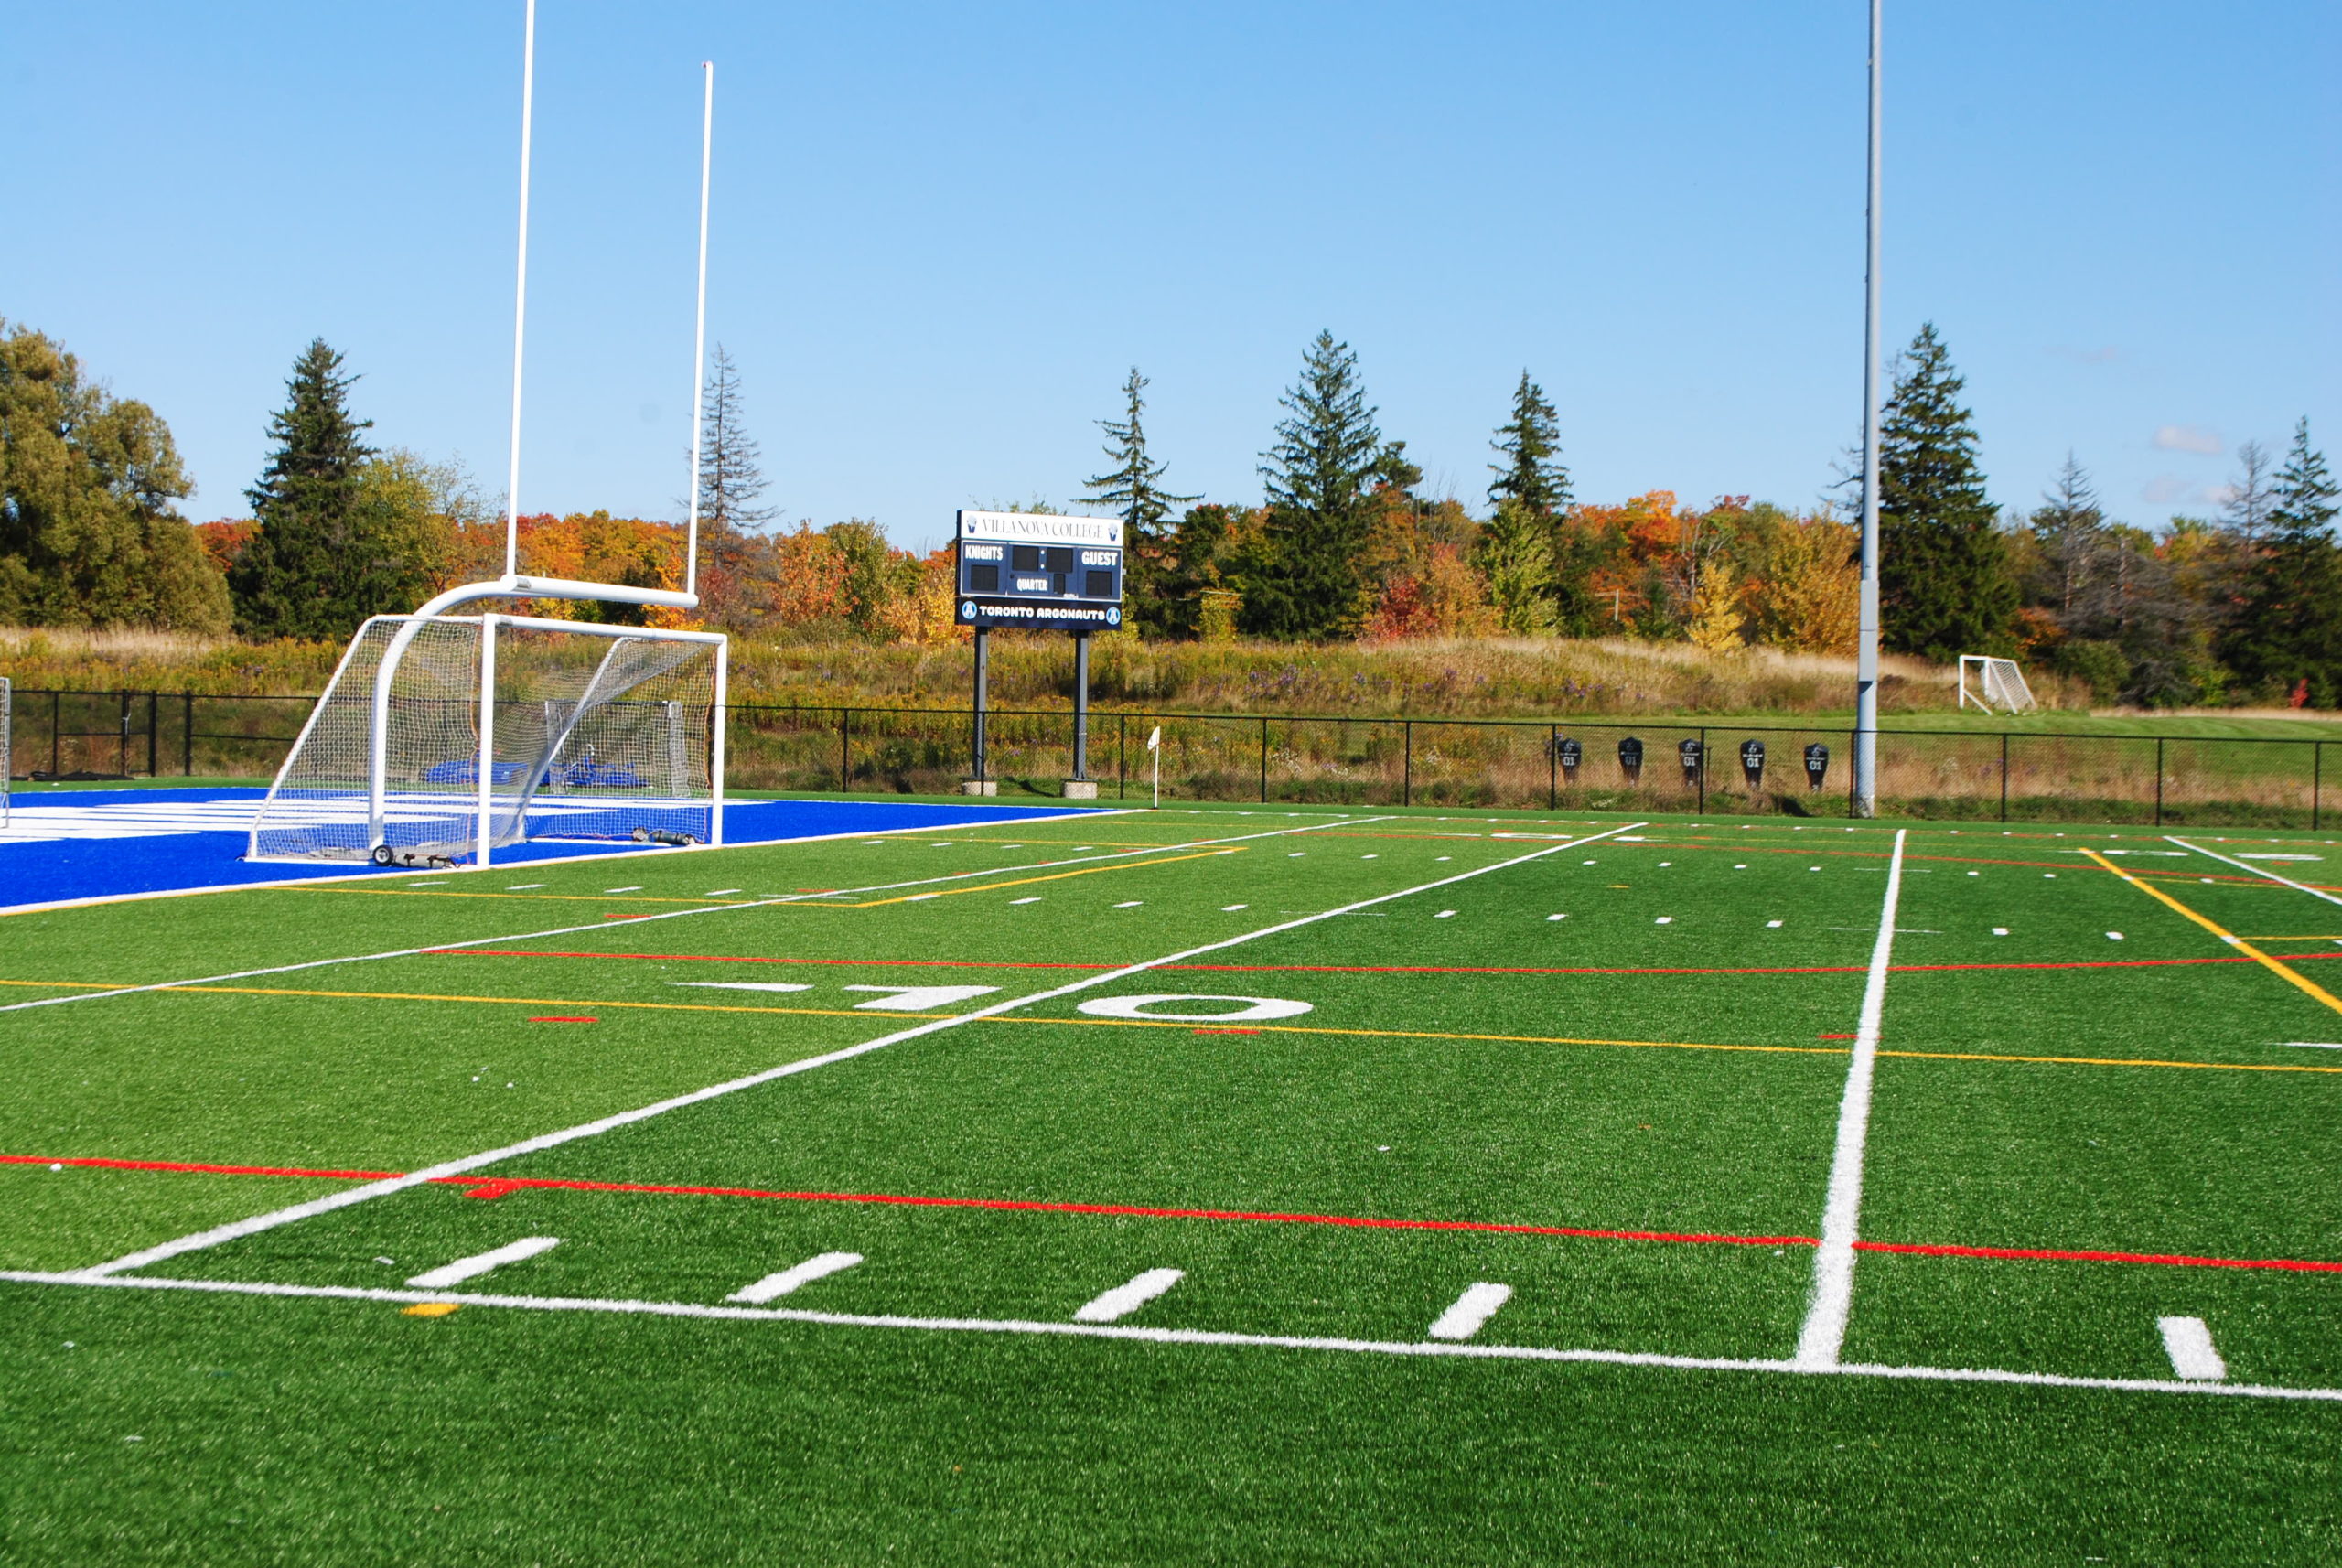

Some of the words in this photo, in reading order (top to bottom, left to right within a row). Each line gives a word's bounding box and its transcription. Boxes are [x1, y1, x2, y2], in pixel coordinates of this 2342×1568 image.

[983, 518, 1048, 536] VILLANOVA
[1052, 522, 1103, 539] COLLEGE
[965, 544, 1004, 561] KNIGHTS
[1081, 551, 1118, 566] GUEST
[1016, 578, 1047, 592] QUARTER
[979, 605, 1035, 618] TORONTO
[1037, 607, 1106, 621] ARGONAUTS
